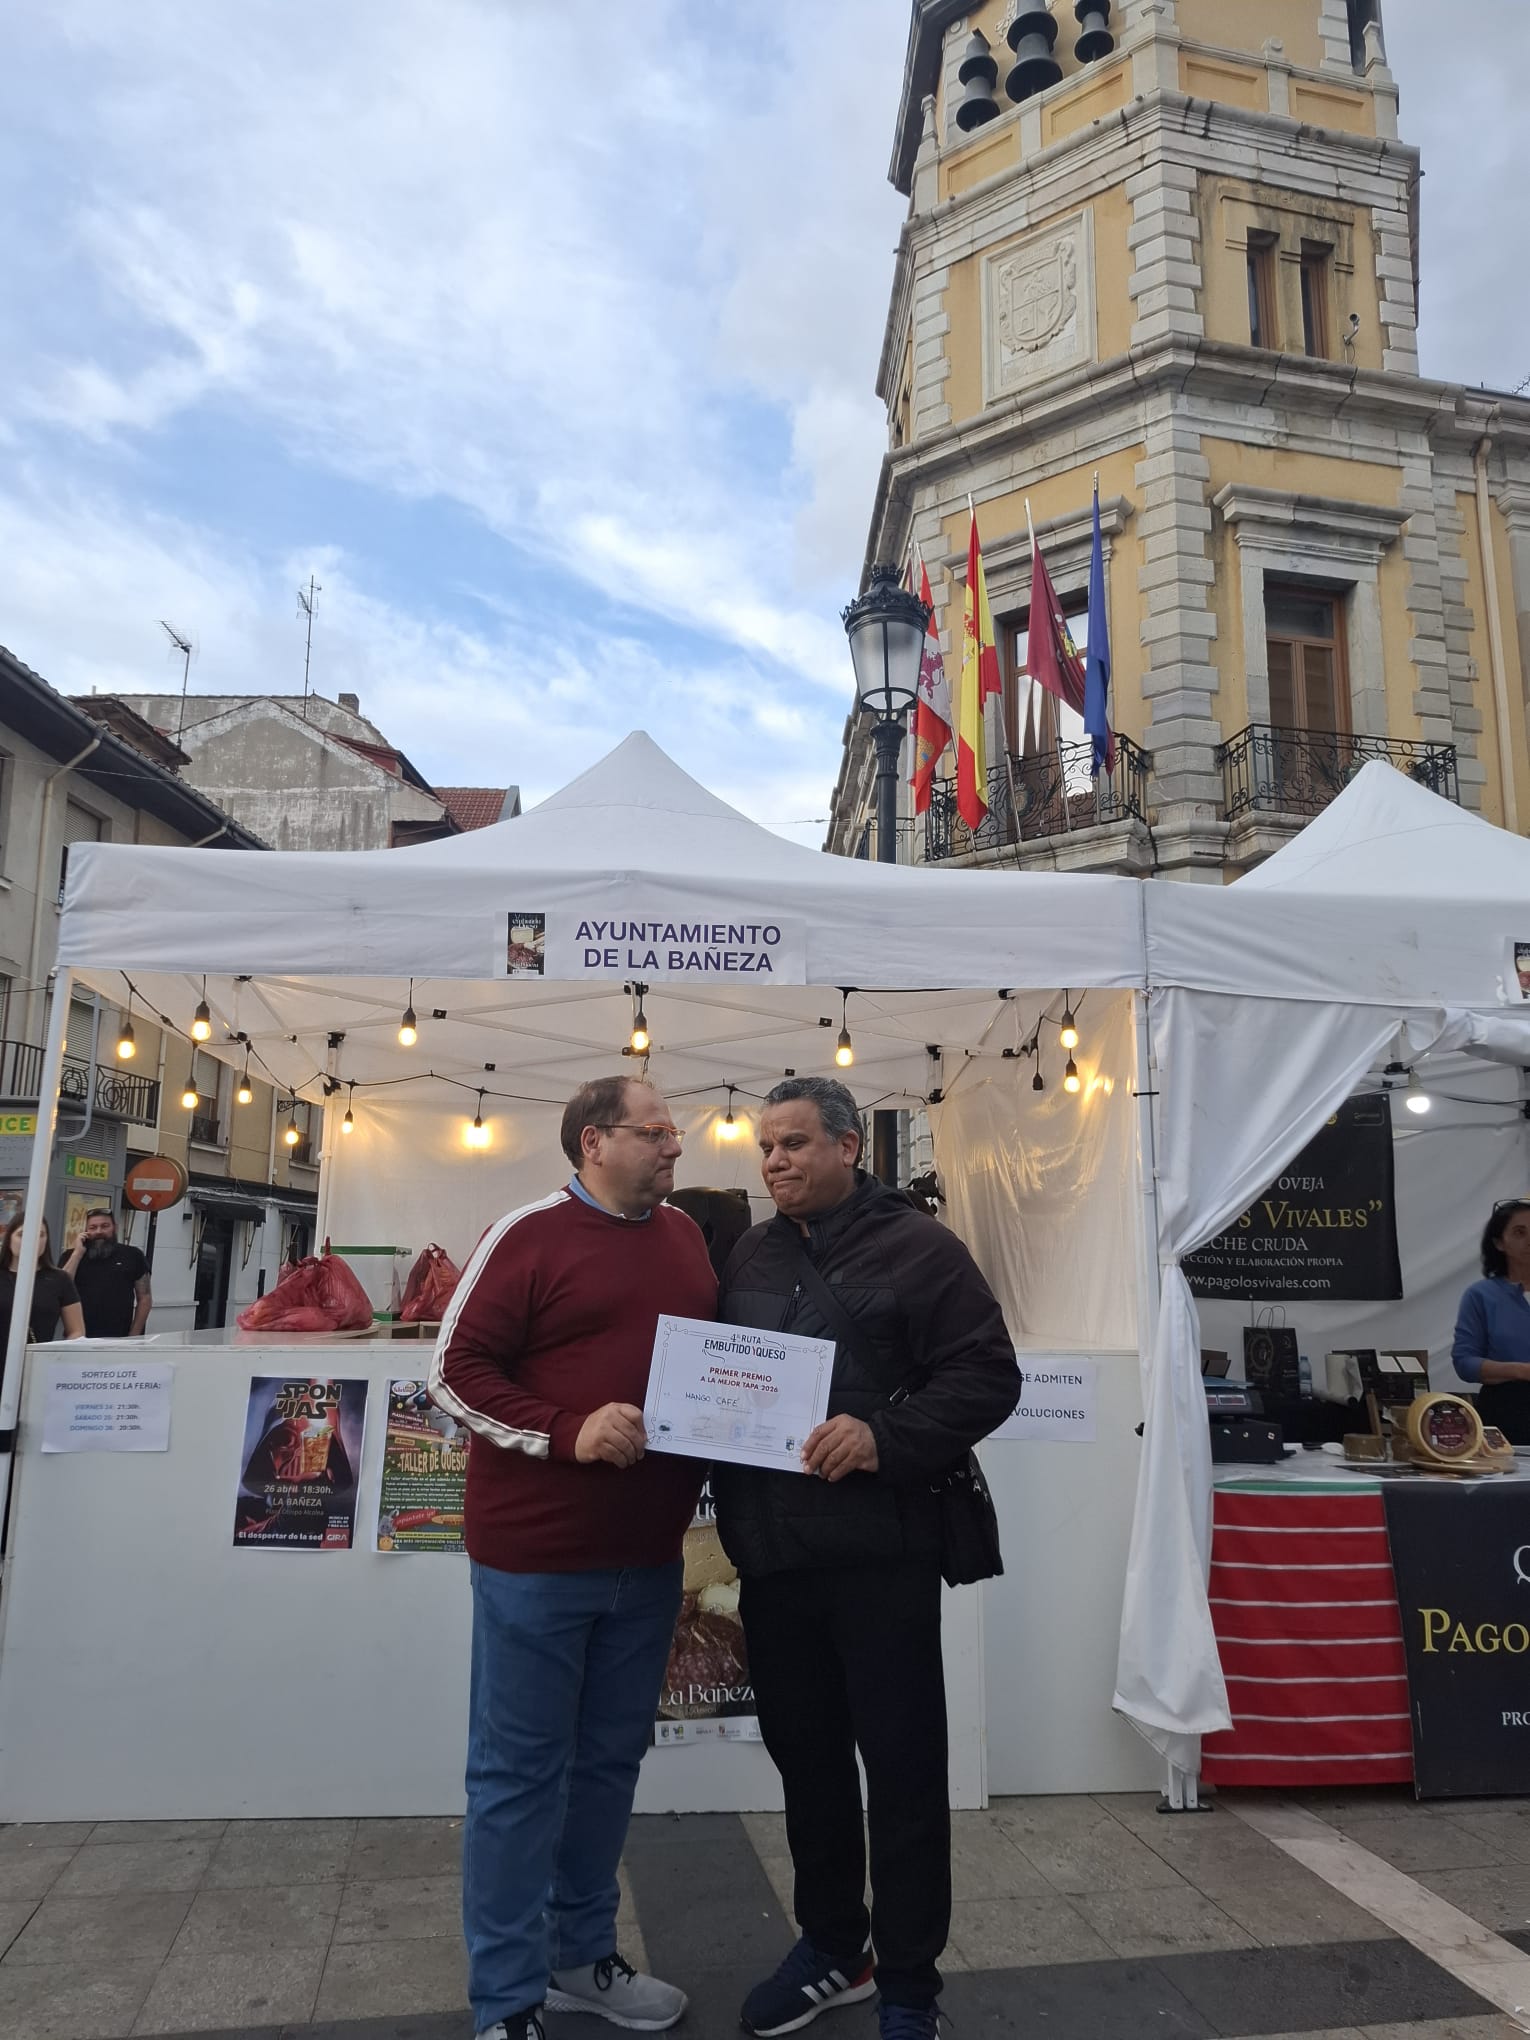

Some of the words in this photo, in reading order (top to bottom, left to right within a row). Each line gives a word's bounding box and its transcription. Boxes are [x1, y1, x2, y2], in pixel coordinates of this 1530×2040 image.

[575, 921, 781, 945] AYUNTAMIENTO
[584, 949, 619, 968] DE
[628, 949, 660, 970] LA
[668, 946, 773, 972] BAÑEZA
[79, 1161, 105, 1178] ONCE
[1278, 1177, 1325, 1192] OVEJA
[1251, 1237, 1310, 1252] CRUDA
[1182, 1254, 1224, 1265] UCCIÓN
[1226, 1257, 1233, 1265] Y
[1235, 1256, 1305, 1266] ELABORACIÓN
[1307, 1258, 1344, 1266] PROPIA
[742, 1334, 762, 1345] RUTA
[704, 1339, 750, 1355] EMBUTIDO
[756, 1347, 786, 1361] QUESO
[710, 1367, 739, 1378] PRIMER
[742, 1371, 772, 1383] PREMIO
[1034, 1374, 1082, 1385] ADMITEN
[135, 1382, 161, 1390] FERIA:
[700, 1375, 706, 1383] A
[708, 1376, 716, 1384] LA
[718, 1377, 740, 1388] MEJOR
[742, 1381, 759, 1391] TAPA
[761, 1384, 778, 1393] 2026
[276, 1383, 342, 1401] SPON
[1011, 1407, 1085, 1419] VOLUCIONES
[400, 1451, 428, 1473] TALLER
[429, 1450, 439, 1472] DE
[441, 1450, 466, 1472] QUESO
[264, 1485, 275, 1493] 26
[277, 1485, 298, 1493] abril
[303, 1486, 334, 1494] 18:30h.
[273, 1498, 284, 1506] LA
[287, 1496, 322, 1507] BAÑEZA
[248, 1532, 287, 1541] despertar
[308, 1533, 323, 1541] sed
